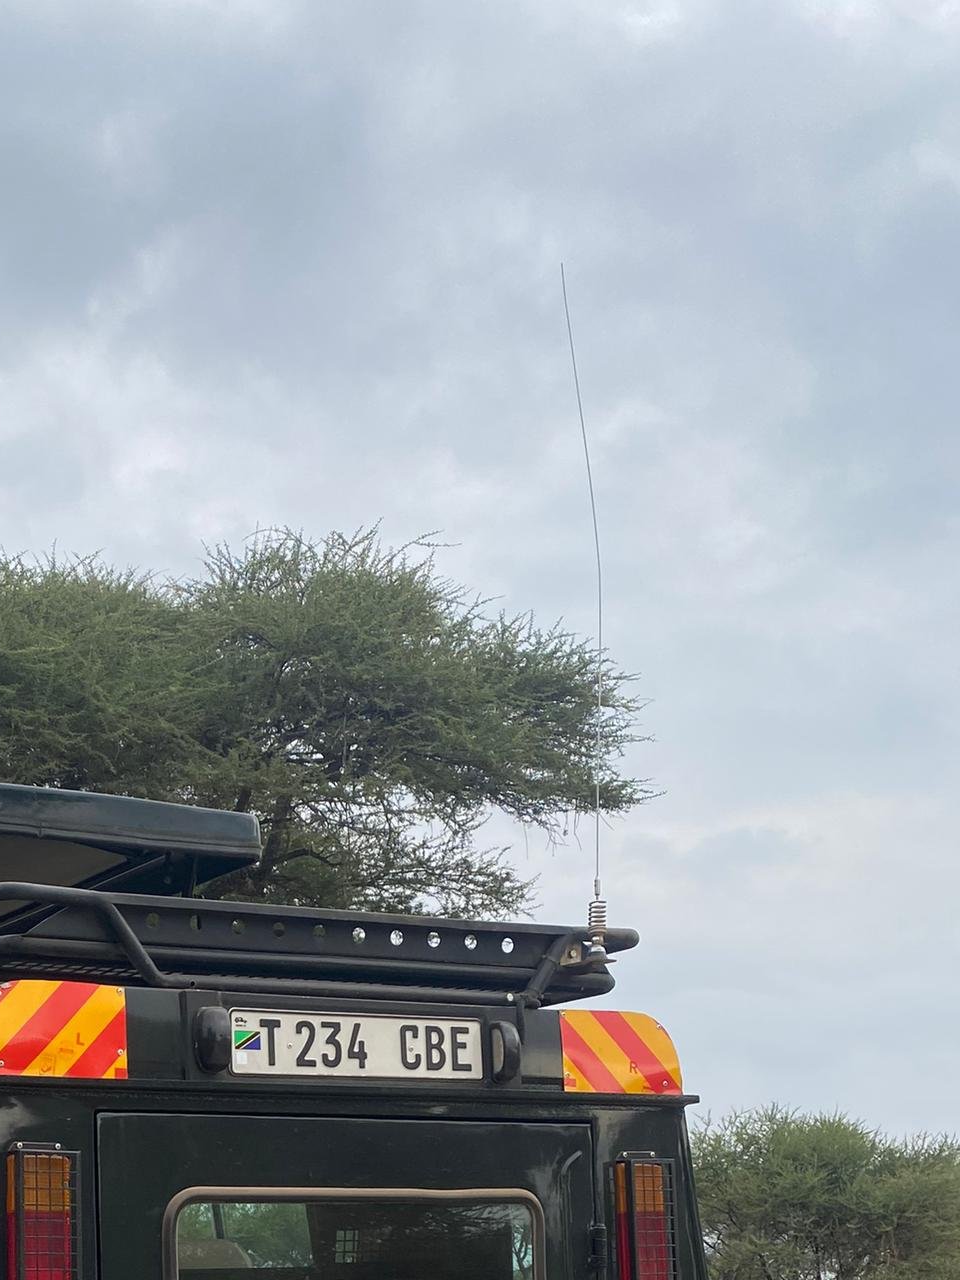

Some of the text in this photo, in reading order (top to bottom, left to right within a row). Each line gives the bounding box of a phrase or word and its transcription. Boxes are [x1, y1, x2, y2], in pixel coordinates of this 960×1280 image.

[259, 1018, 473, 1071] T 234 CBE
